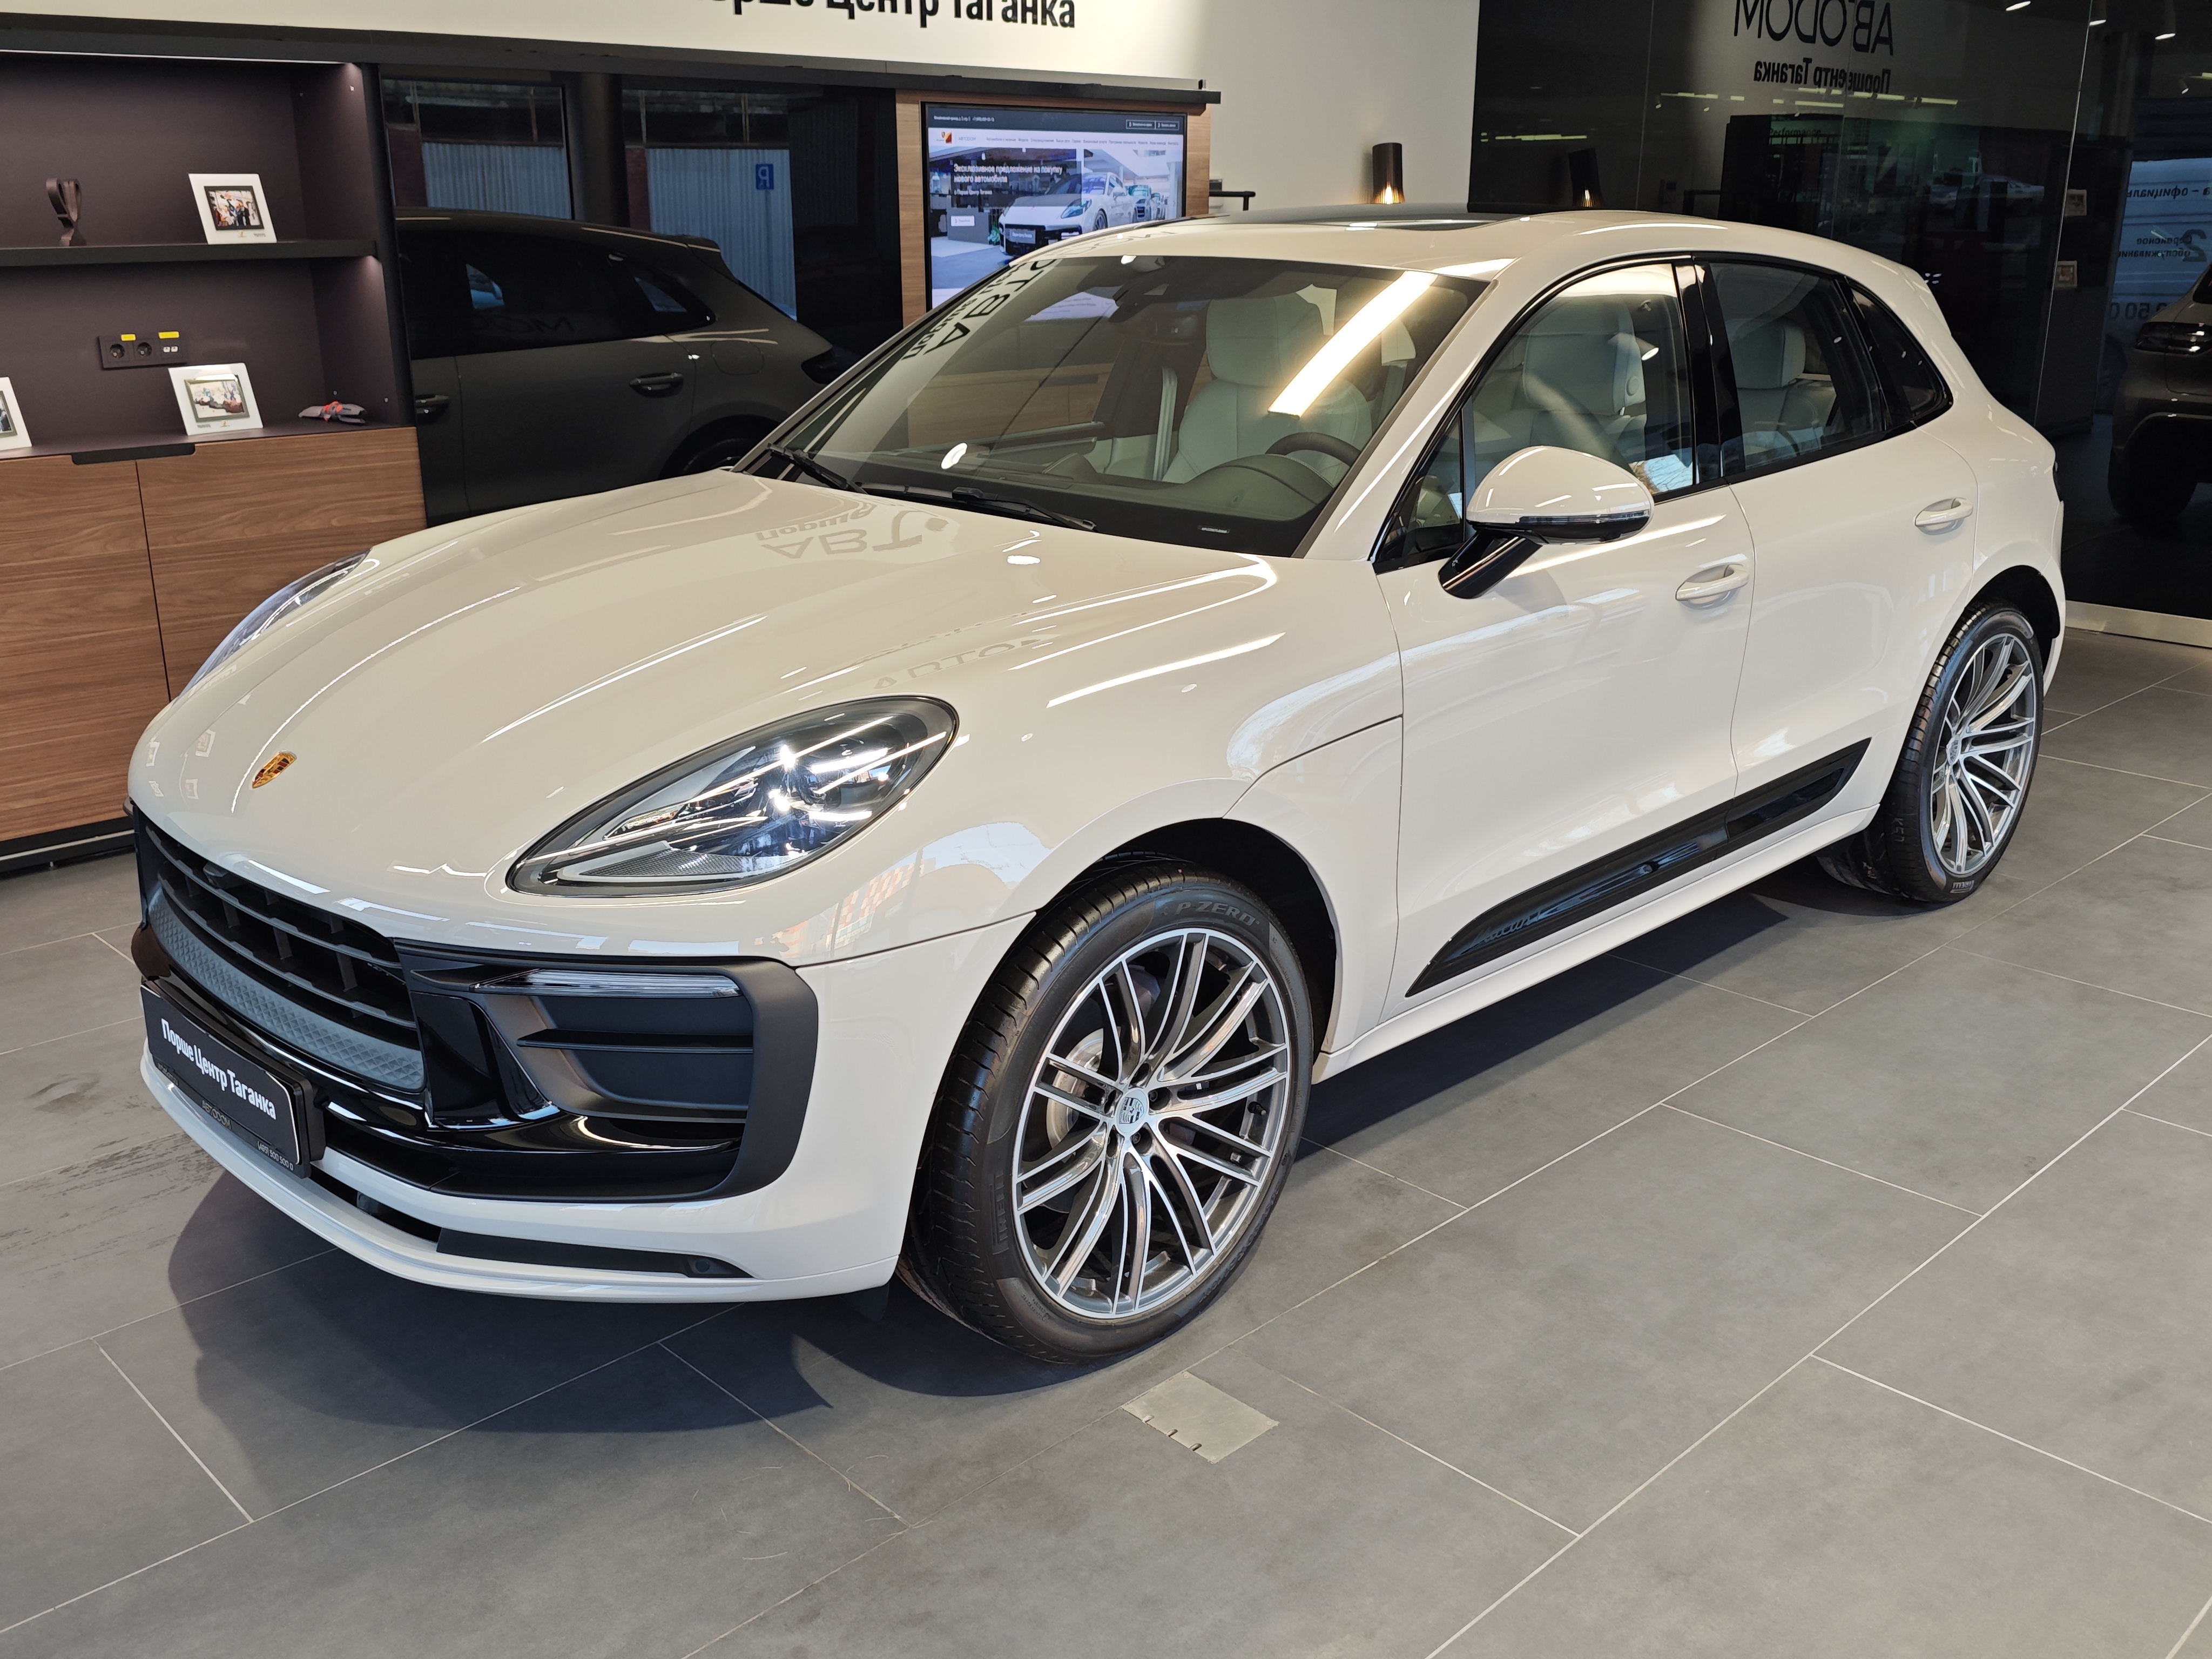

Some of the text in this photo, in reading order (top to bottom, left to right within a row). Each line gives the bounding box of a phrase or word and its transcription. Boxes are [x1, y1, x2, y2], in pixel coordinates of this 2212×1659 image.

[161, 1017, 194, 1062] Порше
[193, 1044, 227, 1091] Центр
[227, 1069, 276, 1120] Таганка
